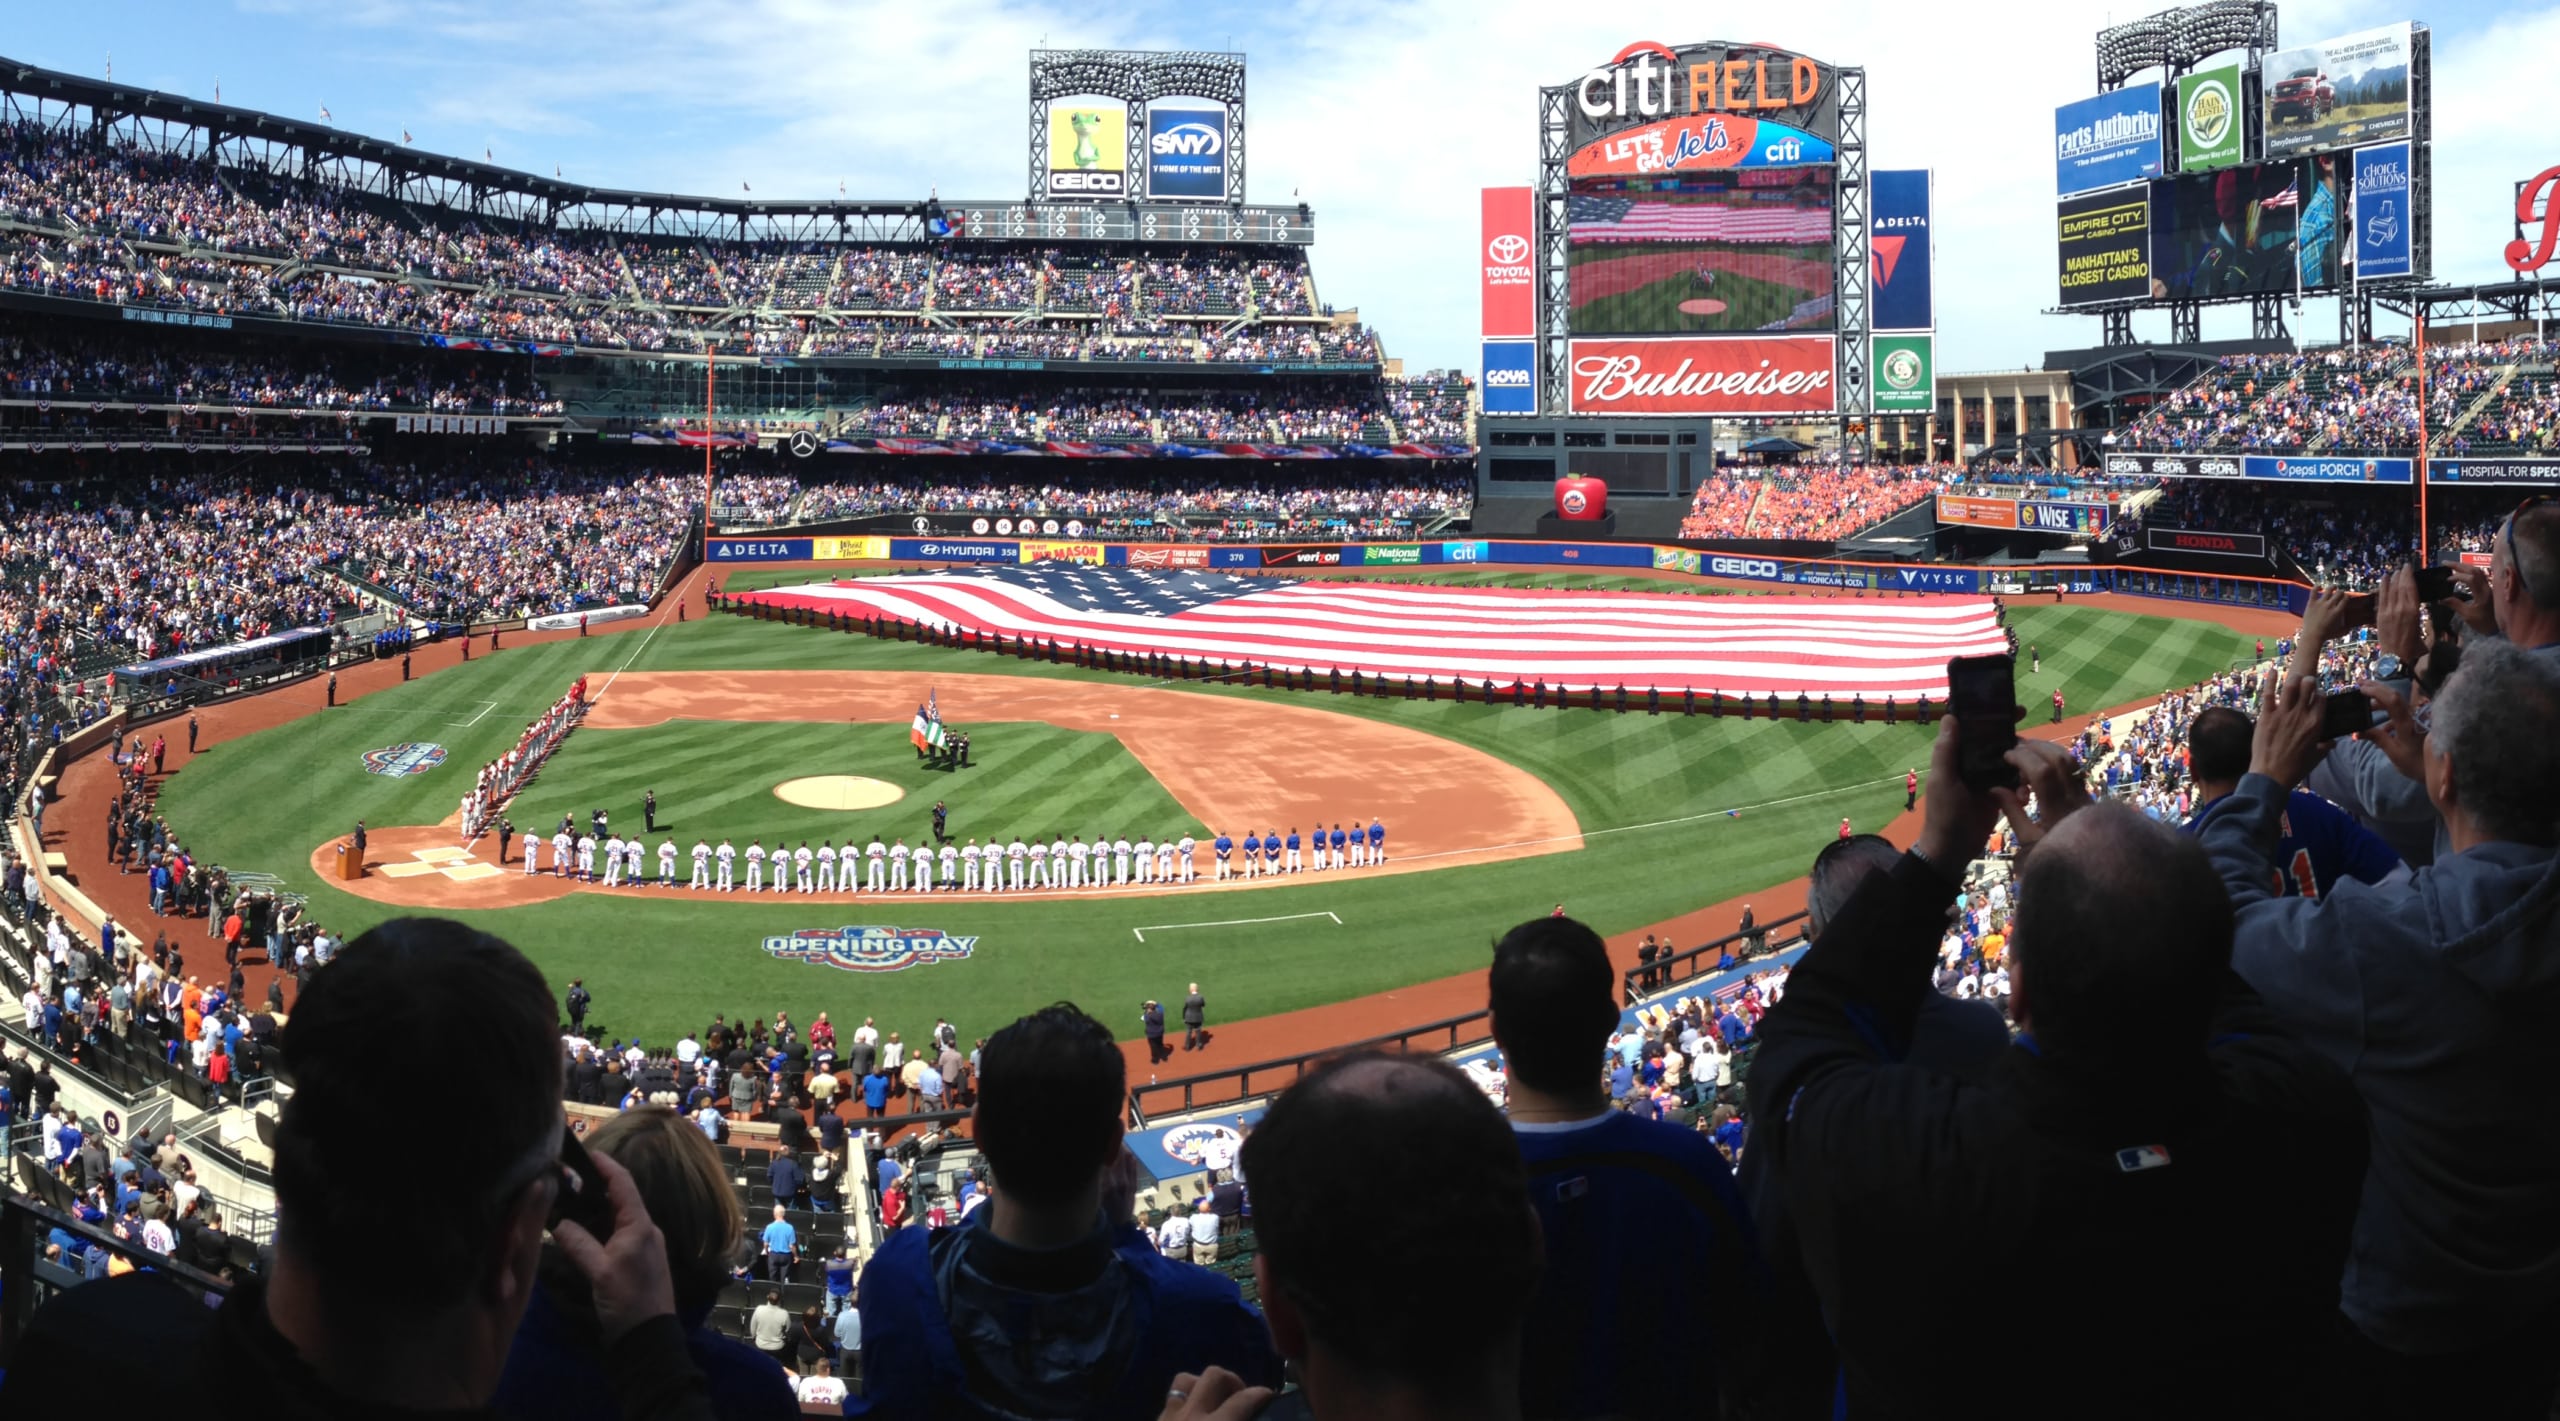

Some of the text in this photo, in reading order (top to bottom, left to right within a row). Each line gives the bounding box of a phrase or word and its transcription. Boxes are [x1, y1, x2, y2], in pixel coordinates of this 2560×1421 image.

[2331, 56, 2340, 64] YOU
[2340, 54, 2355, 62] KNOW
[2355, 51, 2365, 60] YOU
[2365, 49, 2379, 59] WANT
[1578, 54, 1819, 117] citi FIELD
[2197, 96, 2221, 110] HAIN
[2058, 110, 2159, 151] Parts Authority
[2369, 118, 2404, 130] CHEVROLET
[1151, 133, 1213, 156] SNY
[1605, 130, 1665, 163] LET'S
[1666, 118, 1727, 169] Mets
[2271, 134, 2313, 148] ChevyDealer.com
[1765, 142, 1800, 161] citi
[2079, 143, 2101, 154] Parts
[1159, 165, 1179, 173] HOME
[1180, 165, 1189, 173] OF
[1189, 165, 1202, 174] THE
[1203, 166, 1222, 174] METS
[1636, 152, 1664, 173] GO
[2363, 162, 2398, 178] CHOICE
[1051, 173, 1121, 190] GEICO
[2358, 172, 2406, 190] SOLUTIONS
[1887, 216, 1926, 227] DELTA
[2063, 216, 2110, 234] EMPIRE
[2086, 227, 2116, 239] CASINO
[2066, 247, 2140, 272] MANHATTAN'S
[1485, 266, 1531, 278] TOYOTA
[2060, 262, 2149, 287] CLOSEST CASINO
[140, 310, 164, 323] NATIONAL
[192, 316, 213, 327] LAUREN
[1486, 369, 1530, 385] GOYA
[1574, 354, 1830, 401] Budweiser
[2289, 463, 2360, 477] pepsi PORCH
[2461, 466, 2506, 477] HOSPITAL
[2508, 466, 2528, 477] FOR
[976, 522, 986, 530] 37
[2176, 534, 2236, 549] HONDA
[735, 544, 789, 556] DELTA
[942, 545, 995, 556] HYUNDAI
[1001, 548, 1017, 557] 358
[1053, 544, 1098, 559] MASON
[1378, 547, 1420, 558] National
[1453, 547, 1476, 560] citi
[1172, 557, 1184, 565] FOR
[1229, 553, 1244, 562] 370
[1297, 552, 1340, 563] verizon
[1658, 551, 1678, 564] Gulf
[1712, 557, 1777, 577] GEICO
[1781, 573, 1796, 582] 380
[1808, 575, 1833, 585] KONICA
[2074, 582, 2092, 593] 370
[766, 937, 977, 952] OPENING DAY
